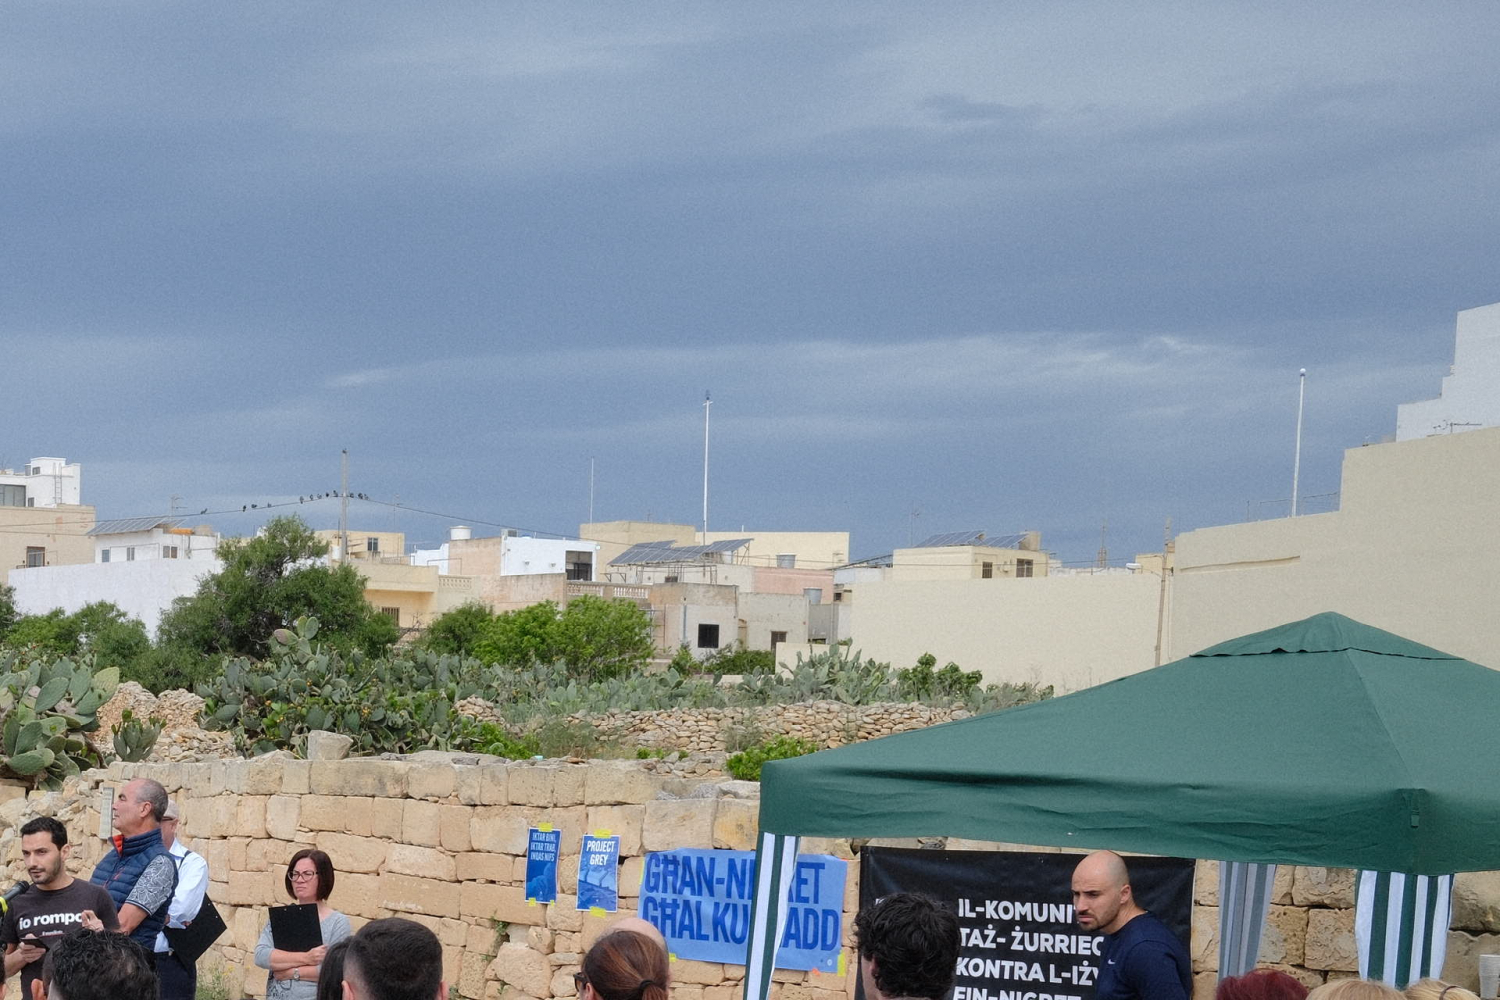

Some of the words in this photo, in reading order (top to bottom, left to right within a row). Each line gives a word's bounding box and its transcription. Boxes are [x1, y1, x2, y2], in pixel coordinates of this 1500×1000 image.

[587, 841, 615, 853] PROJECT
[590, 854, 609, 865] GREY
[644, 852, 825, 904] GĦAN-NIET
[19, 917, 31, 930] io
[958, 898, 1076, 924] IL-KOMUNI
[711, 900, 840, 951] KUADD
[955, 957, 1045, 983] KONTRA
